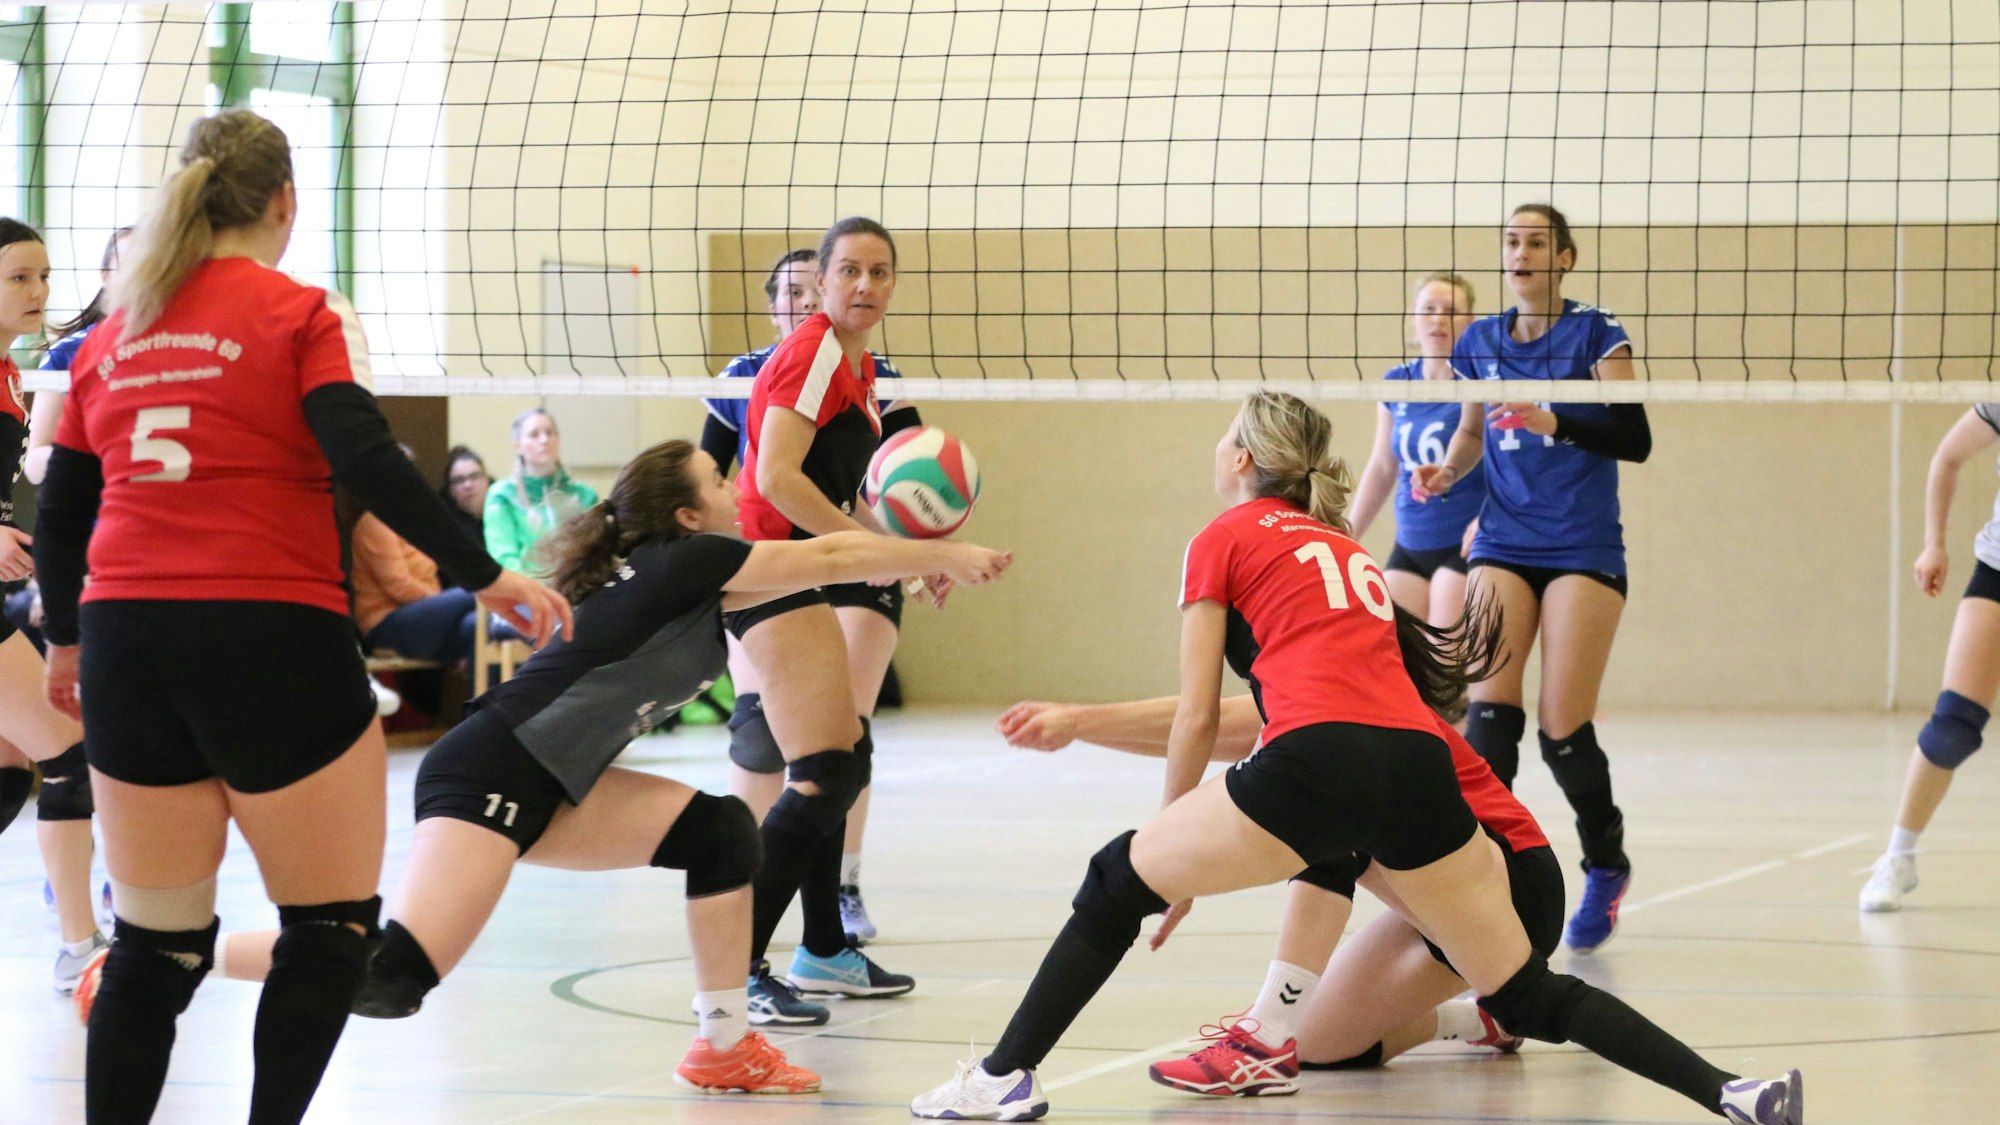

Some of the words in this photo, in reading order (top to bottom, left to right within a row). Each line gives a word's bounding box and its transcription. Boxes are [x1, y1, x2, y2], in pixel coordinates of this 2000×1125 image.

[129, 405, 192, 482] 5
[1399, 421, 1446, 471] 16
[1258, 514, 1280, 528] SG
[1293, 541, 1394, 622] 16
[484, 793, 519, 827] 11
